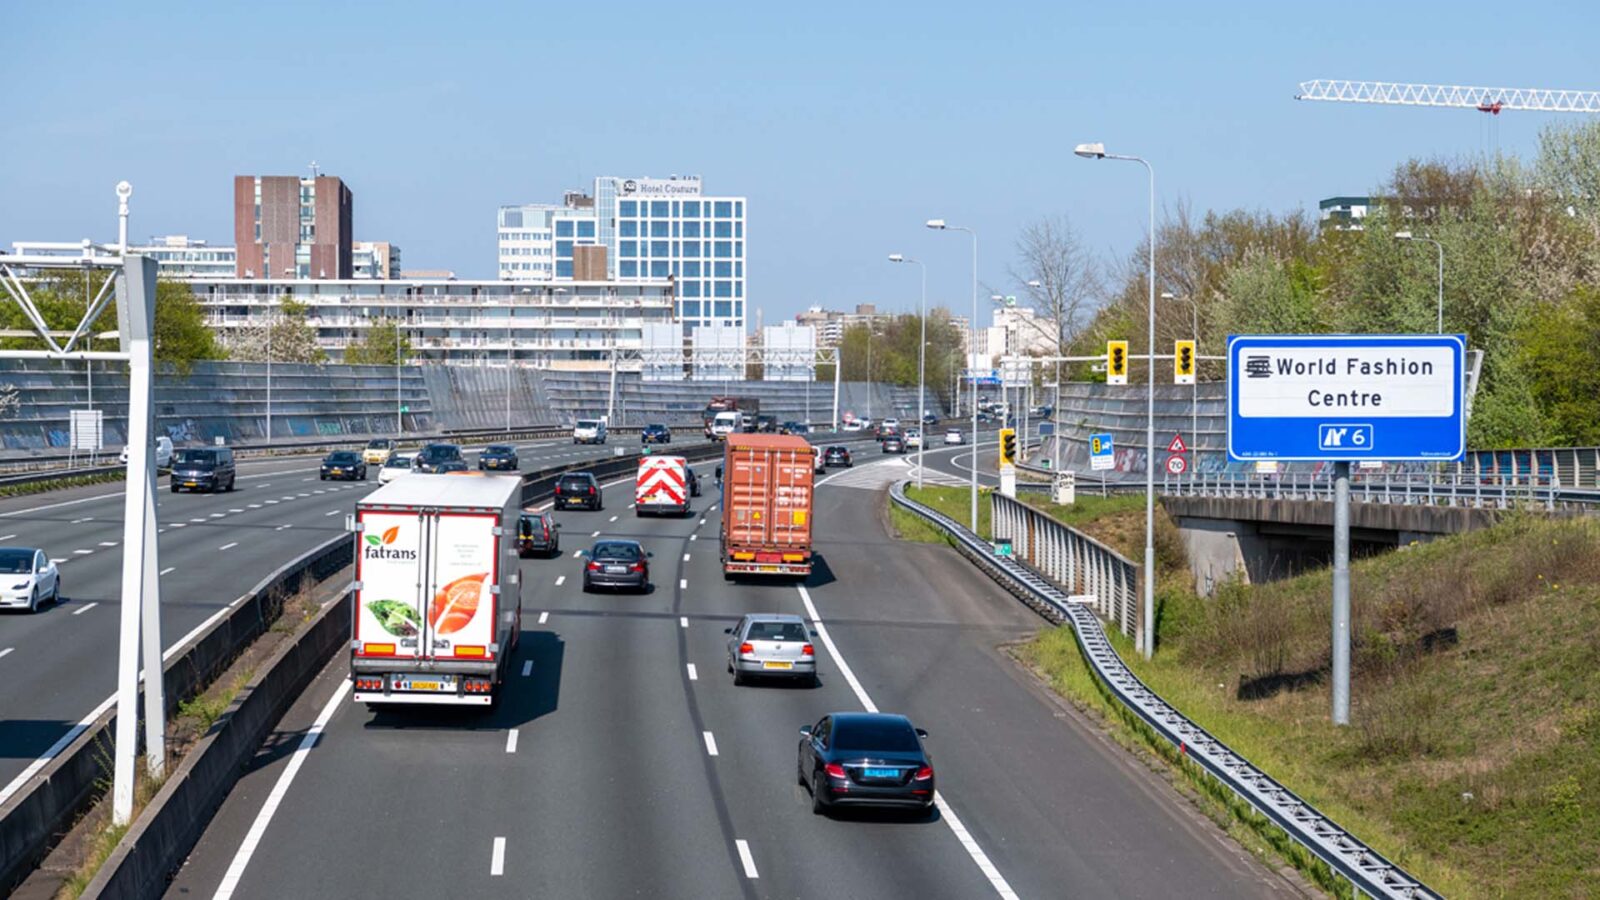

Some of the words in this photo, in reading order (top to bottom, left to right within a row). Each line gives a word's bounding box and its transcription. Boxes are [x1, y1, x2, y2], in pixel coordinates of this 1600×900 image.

[640, 184, 663, 193] Hotel
[665, 184, 698, 194] Couture
[1277, 358, 1336, 376] World
[1347, 358, 1433, 376] Fashion
[1308, 389, 1382, 407] Centre
[1352, 429, 1365, 445] 6
[1170, 461, 1183, 470] 70
[364, 545, 417, 560] fatrans
